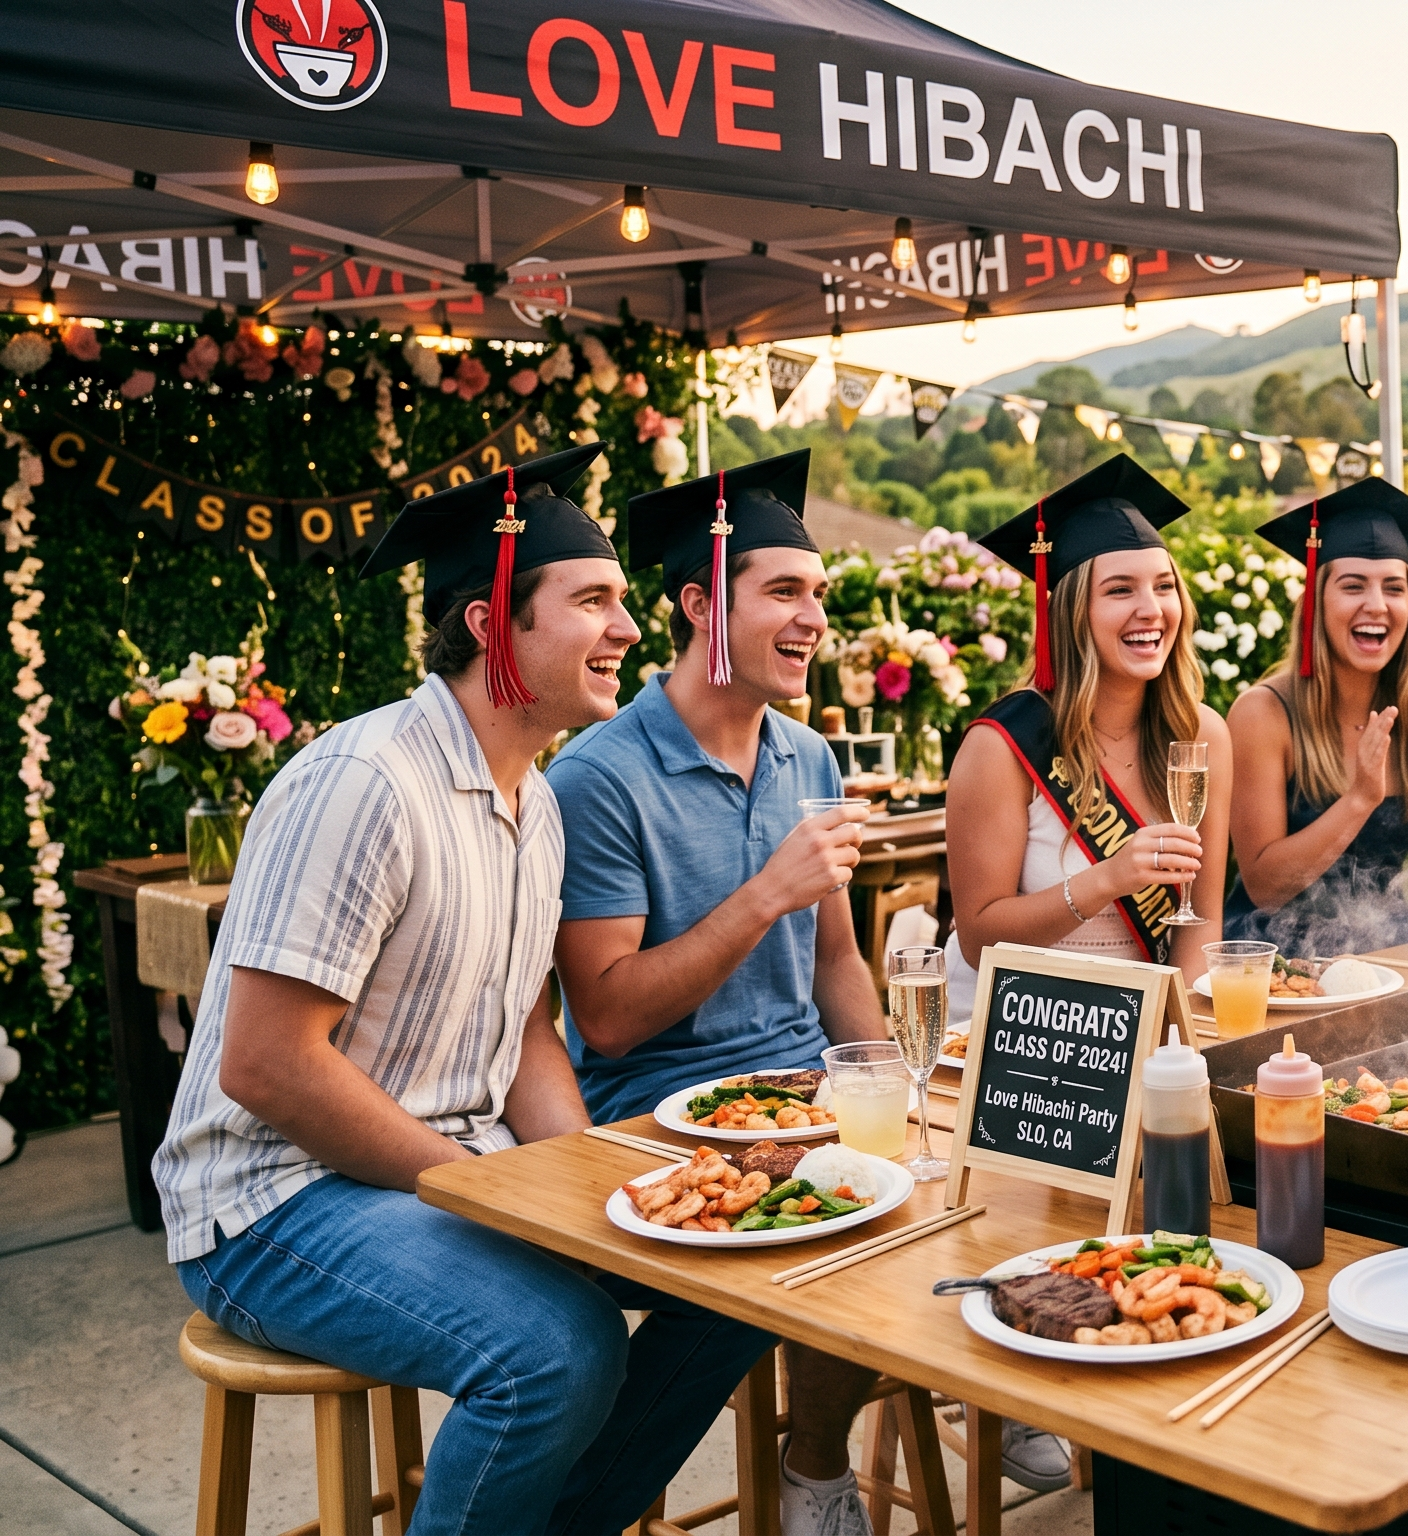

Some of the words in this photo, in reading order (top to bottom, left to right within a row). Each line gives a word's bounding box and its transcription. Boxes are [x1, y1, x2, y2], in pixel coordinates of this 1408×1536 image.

[443, 0, 782, 152] LOVE
[819, 62, 1205, 213] HIBACHI
[1001, 991, 1130, 1042] CONGRATS
[994, 1029, 1048, 1060] CLASS
[1052, 1039, 1076, 1064] OF
[1077, 1044, 1128, 1075] 2024!
[984, 1084, 1019, 1109] Love
[1021, 1091, 1076, 1121] Hibachi
[1078, 1102, 1118, 1134] Party
[1016, 1120, 1048, 1149] SLO,
[1053, 1127, 1073, 1151] CA
